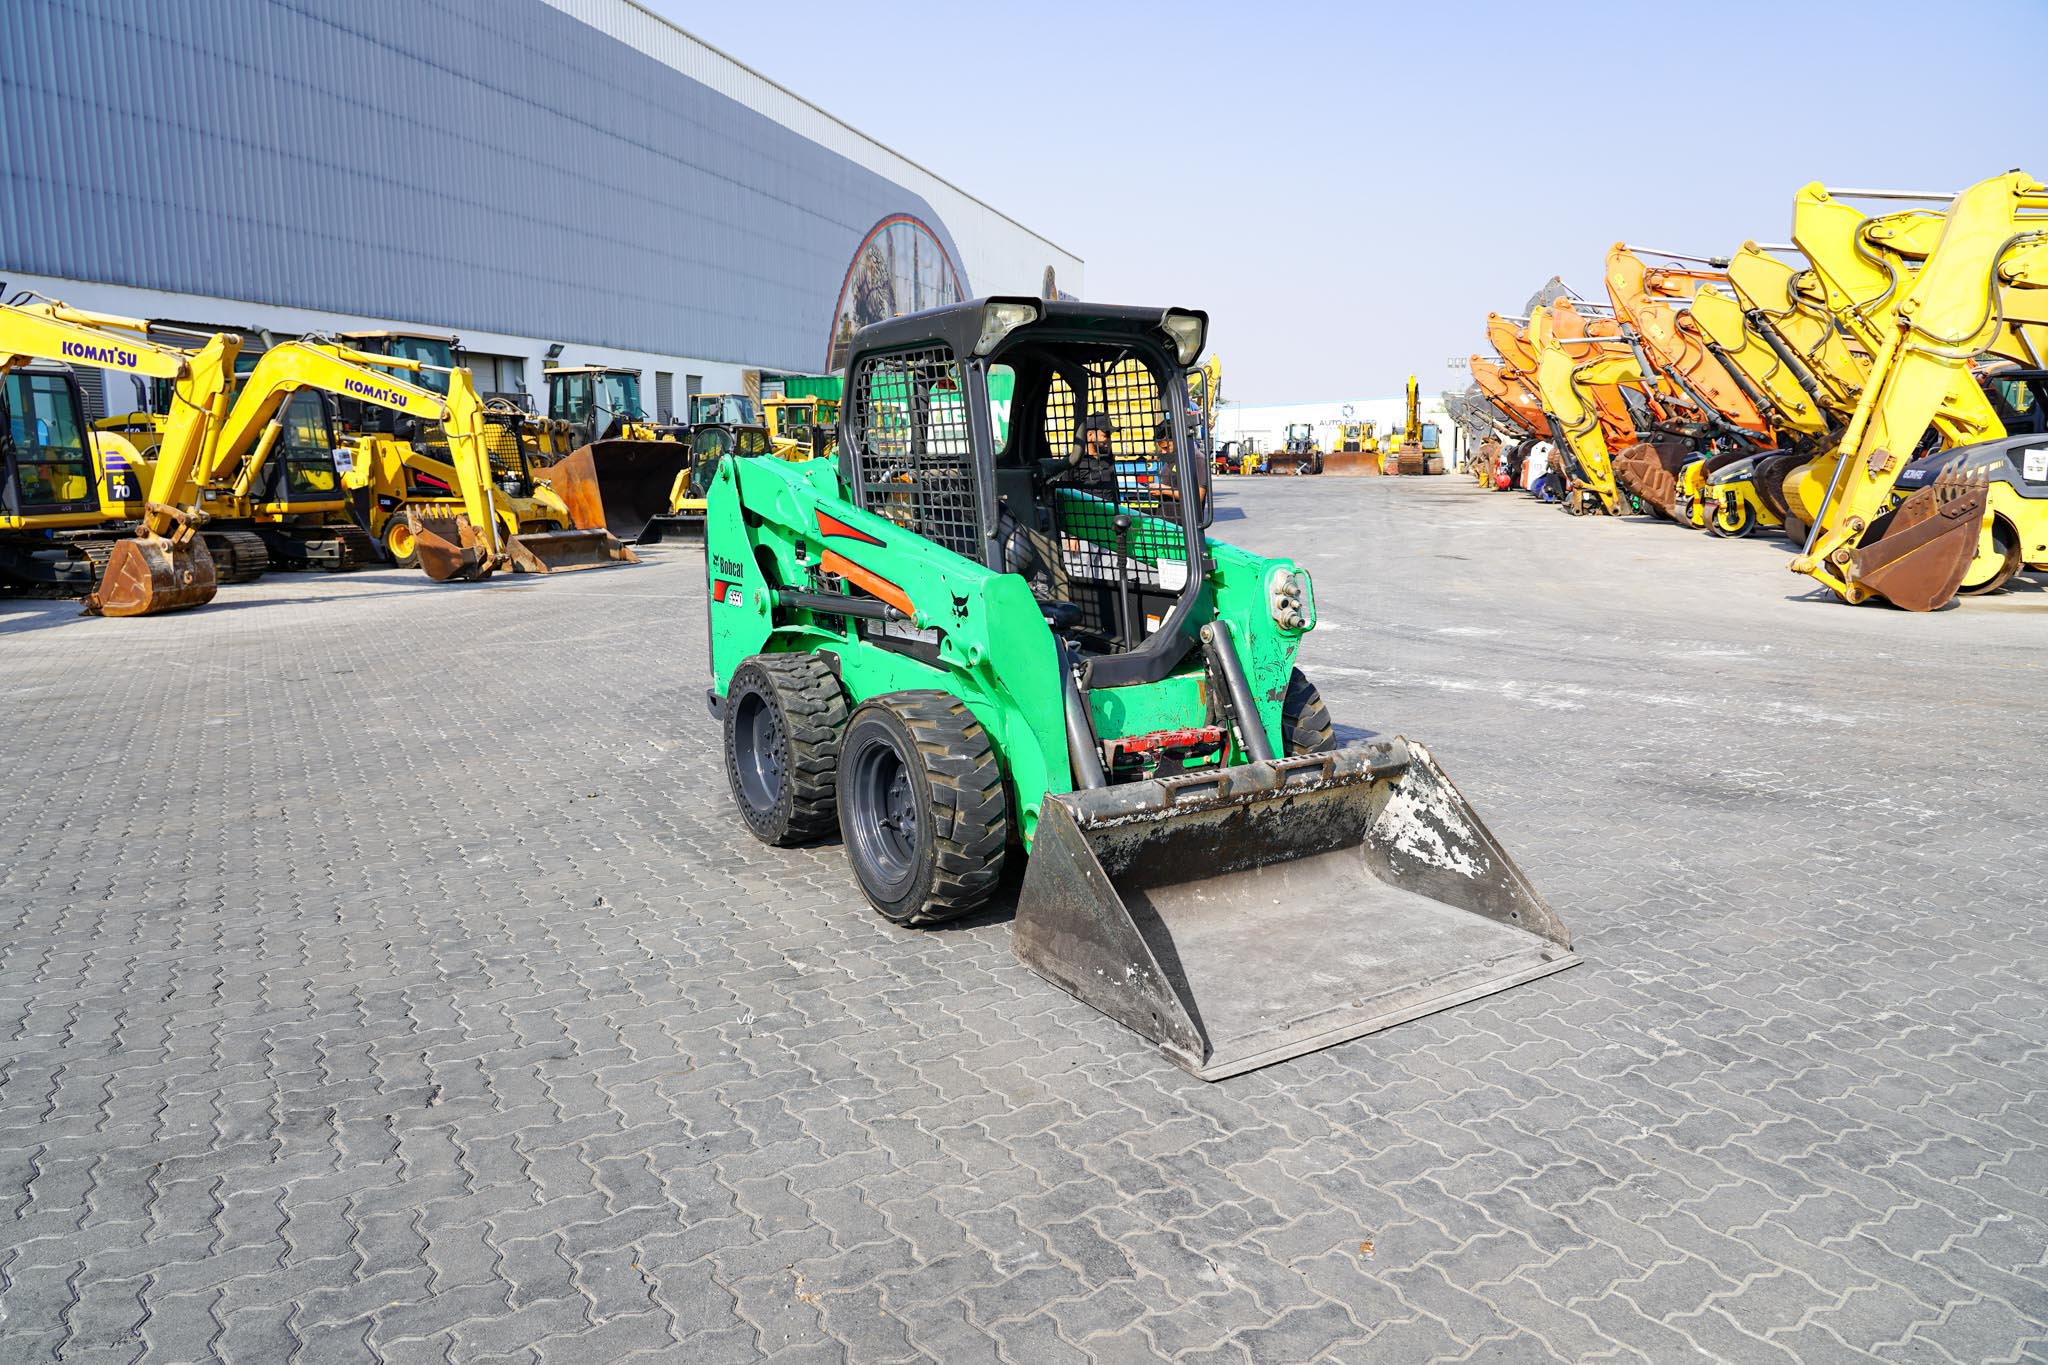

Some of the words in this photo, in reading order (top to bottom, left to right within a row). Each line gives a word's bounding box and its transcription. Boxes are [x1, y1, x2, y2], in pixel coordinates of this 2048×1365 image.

[62, 341, 137, 367] KOMATSU
[344, 378, 407, 407] KOMATSU
[112, 475, 125, 485] PC
[113, 485, 131, 498] 70
[720, 556, 744, 579] Bobcat
